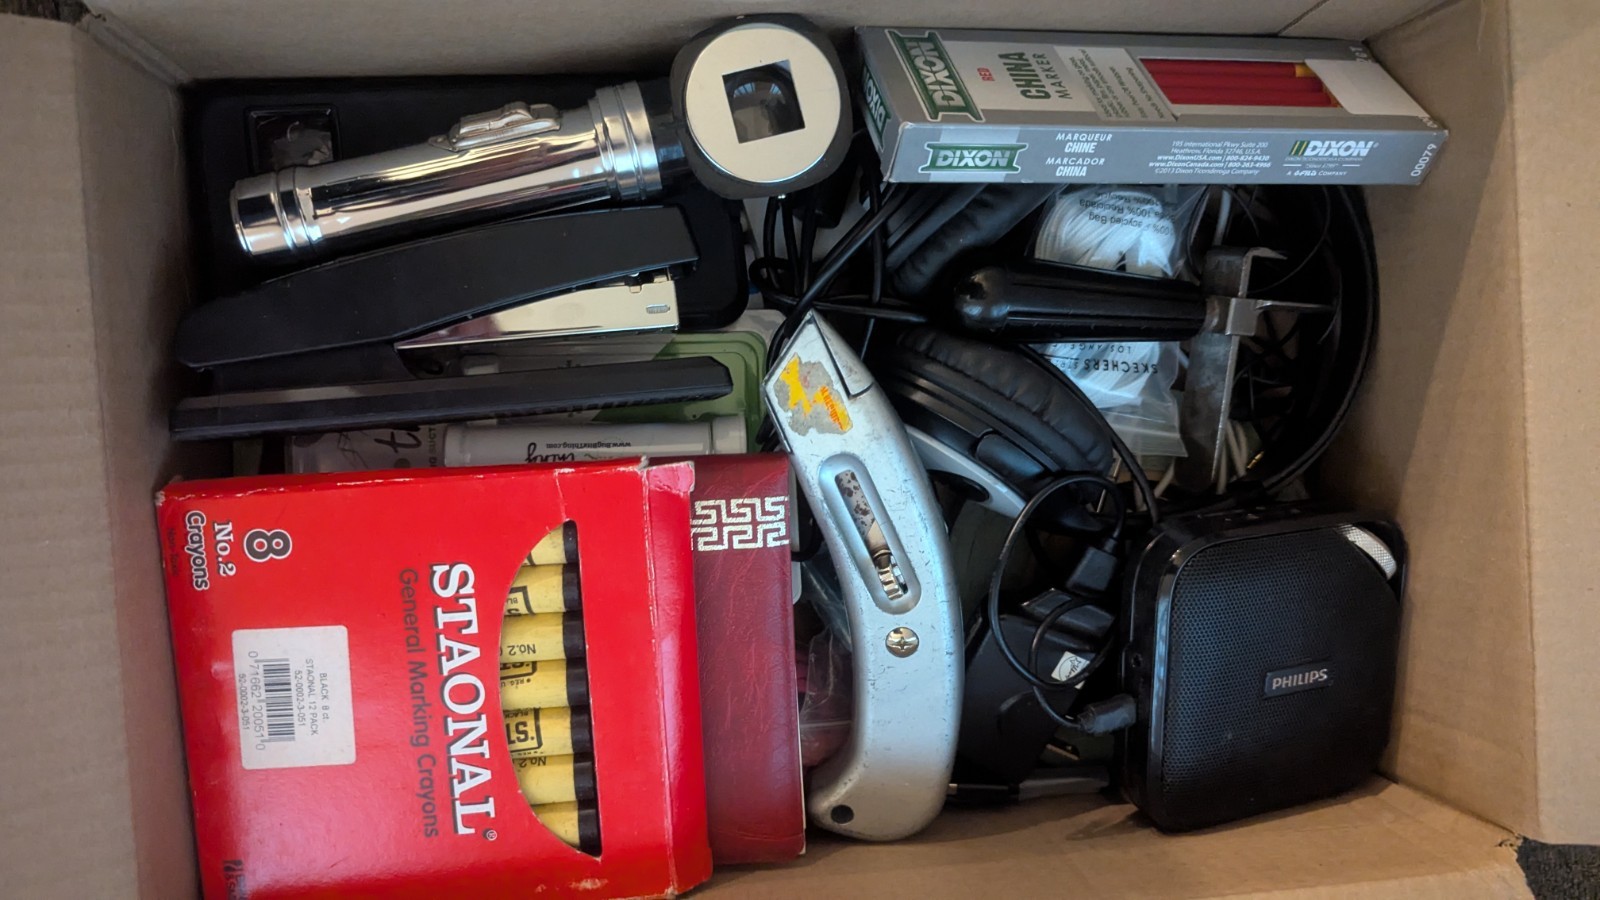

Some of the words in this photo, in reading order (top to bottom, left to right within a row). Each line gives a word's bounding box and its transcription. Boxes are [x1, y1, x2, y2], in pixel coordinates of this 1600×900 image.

[905, 41, 966, 106] DIXON
[977, 67, 994, 81] RED
[998, 52, 1051, 100] CHINA
[1033, 52, 1073, 100] MARKER
[1055, 133, 1113, 142] MARQUEUR
[1064, 142, 1098, 154] CHINE
[1304, 140, 1374, 157] DIXON
[936, 149, 1010, 168] DIXON
[1045, 157, 1106, 166] MARCADOR
[1410, 143, 1437, 177] 00079
[1055, 165, 1087, 177] CHINA
[1079, 199, 1124, 214] Reciclada
[1127, 206, 1151, 218] 100%
[1088, 212, 1107, 225] Bag
[1110, 344, 1132, 354] LOS
[1083, 358, 1159, 375] SKECHERS
[185, 510, 210, 591] Crayons
[214, 521, 236, 577] No.2
[243, 528, 293, 563] 8
[399, 568, 426, 650] General
[509, 643, 537, 656] No.2
[249, 664, 261, 699] 71662
[306, 658, 316, 697] STAONAL
[320, 672, 330, 700] BLACK
[1271, 668, 1329, 690] PHILIPS
[294, 670, 306, 727] 52-0002-3-051
[309, 701, 317, 711] 12
[406, 660, 431, 748] Marking
[252, 705, 264, 739] 20051
[310, 713, 319, 736] PACK
[415, 753, 439, 838] Crayons
